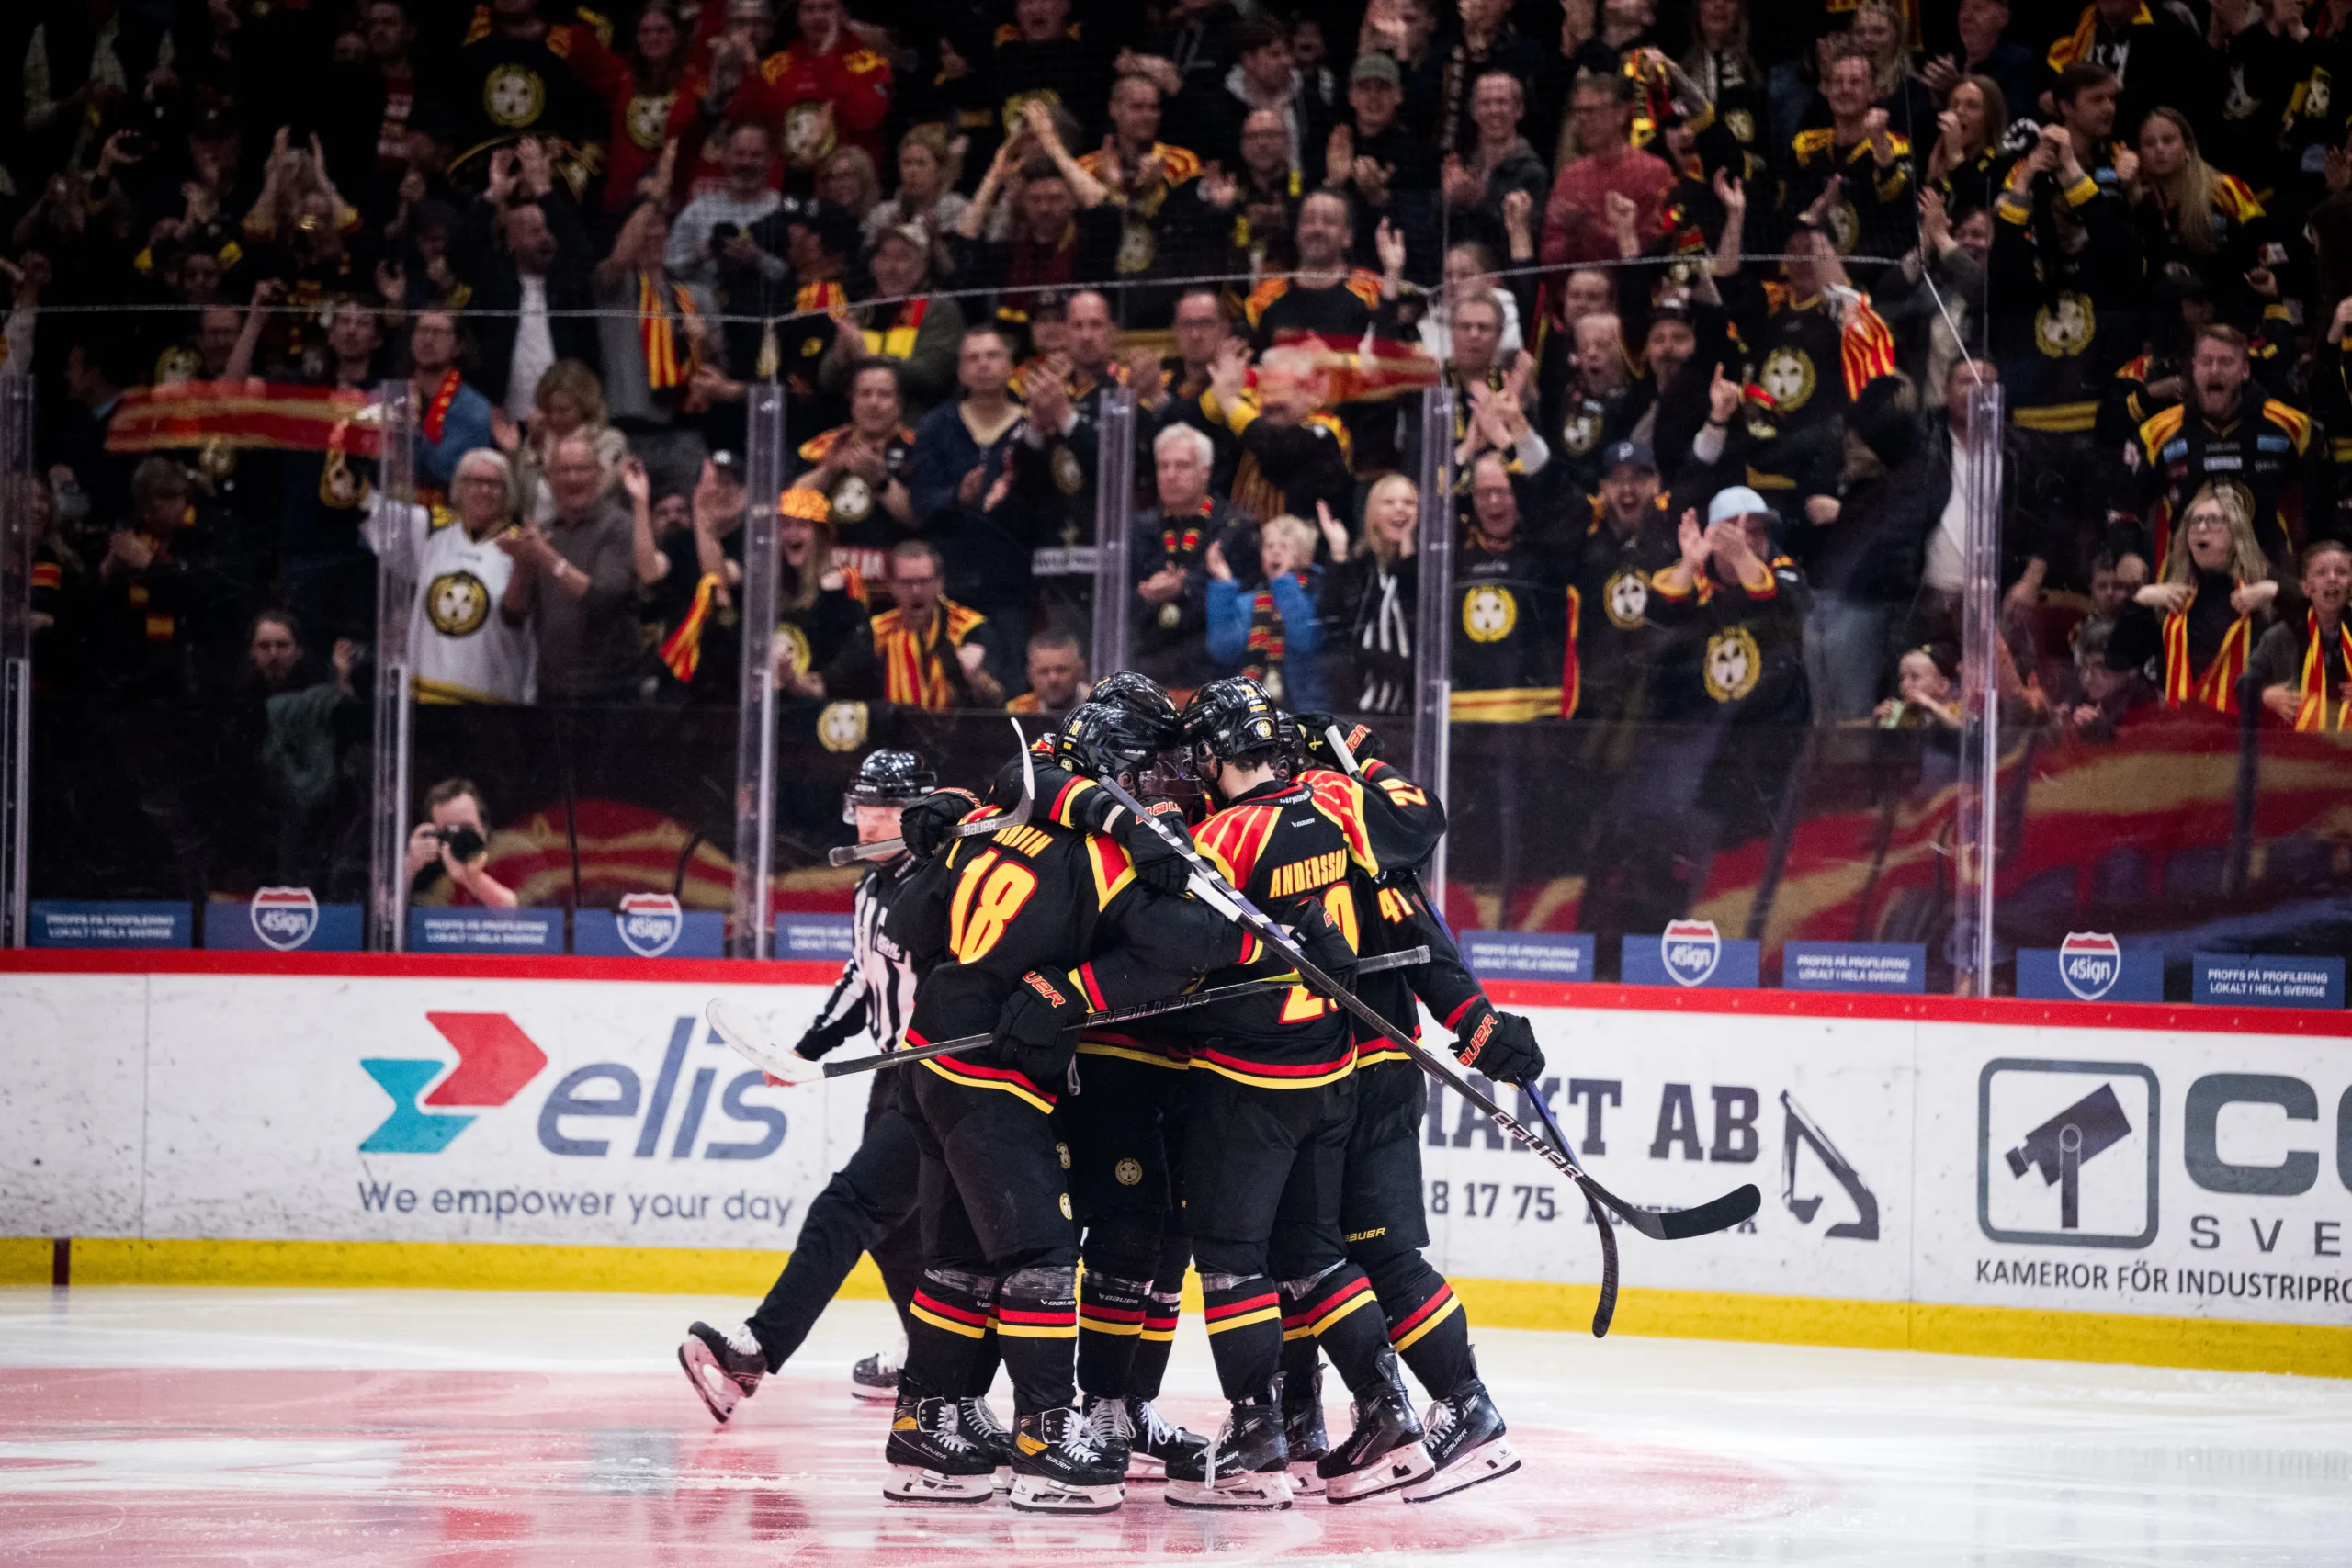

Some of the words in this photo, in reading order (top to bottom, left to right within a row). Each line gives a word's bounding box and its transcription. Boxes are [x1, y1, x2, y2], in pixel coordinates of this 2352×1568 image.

[964, 819, 997, 837] BAUER
[949, 846, 1039, 964] 18
[1377, 887, 1415, 925] 41
[2068, 956, 2111, 986] 4Sign
[2208, 968, 2245, 981] PROFFS
[2247, 967, 2260, 981] PÅ
[2263, 970, 2328, 984] PROFILERING
[2210, 981, 2246, 994] LOKALT
[2255, 984, 2280, 996] HELA
[2283, 985, 2325, 998] SVERIGE
[537, 1016, 787, 1160] elis
[1650, 1082, 1759, 1164] AB
[2185, 1072, 2352, 1196] C
[1491, 1111, 1584, 1181] BAUER
[357, 1181, 417, 1213] We
[432, 1190, 615, 1221] empower
[628, 1192, 709, 1225] your
[724, 1190, 793, 1228] day
[1464, 1181, 1500, 1218] 17
[1513, 1185, 1555, 1222] 75
[1976, 1259, 2107, 1288] KAMEROR
[2118, 1260, 2168, 1293] FÖR
[1104, 1295, 1139, 1304] BAUER
[920, 1442, 947, 1461] BAUER
[1045, 1453, 1073, 1472] BAUER
